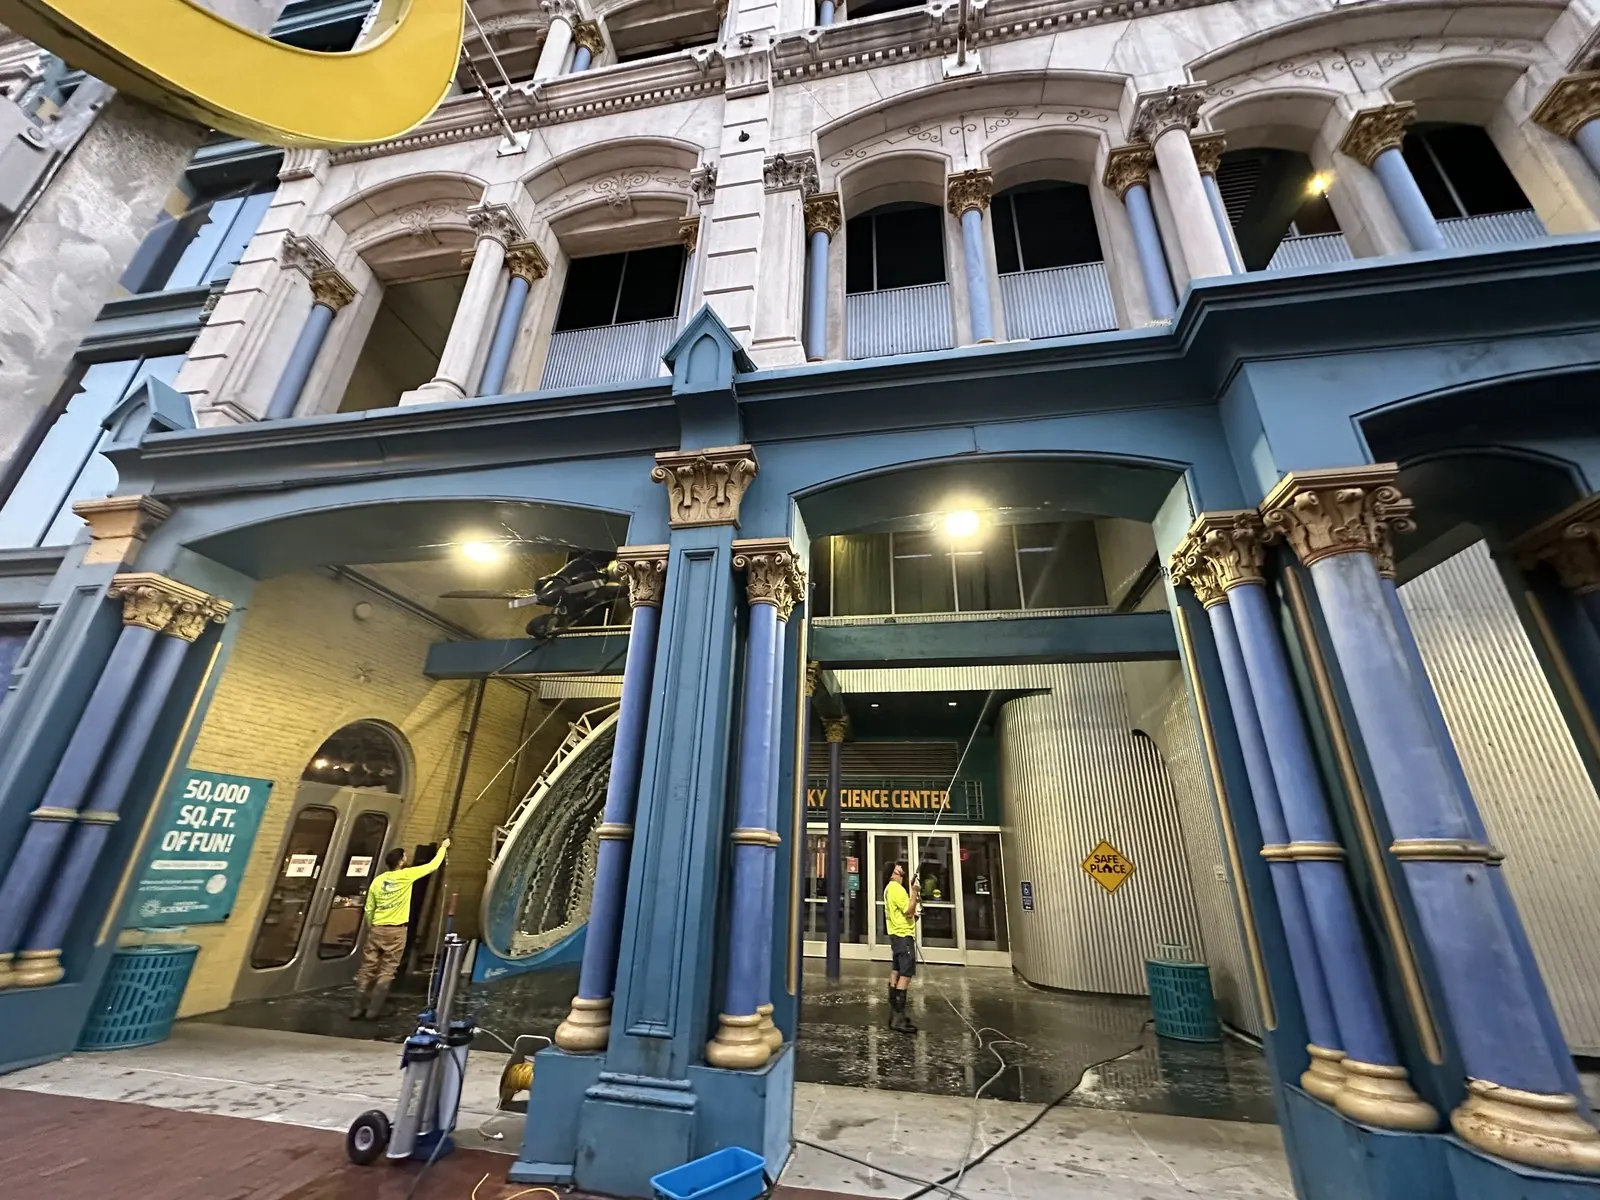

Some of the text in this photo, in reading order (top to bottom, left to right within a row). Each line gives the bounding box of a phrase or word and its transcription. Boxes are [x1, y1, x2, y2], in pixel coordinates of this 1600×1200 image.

[183, 779, 251, 804] 50,000
[840, 789, 890, 808] CIENCE
[892, 789, 951, 809] CENTER
[176, 805, 236, 829] SQ. FT.
[161, 831, 235, 853] OF FUN!
[1094, 854, 1118, 863] SAFE
